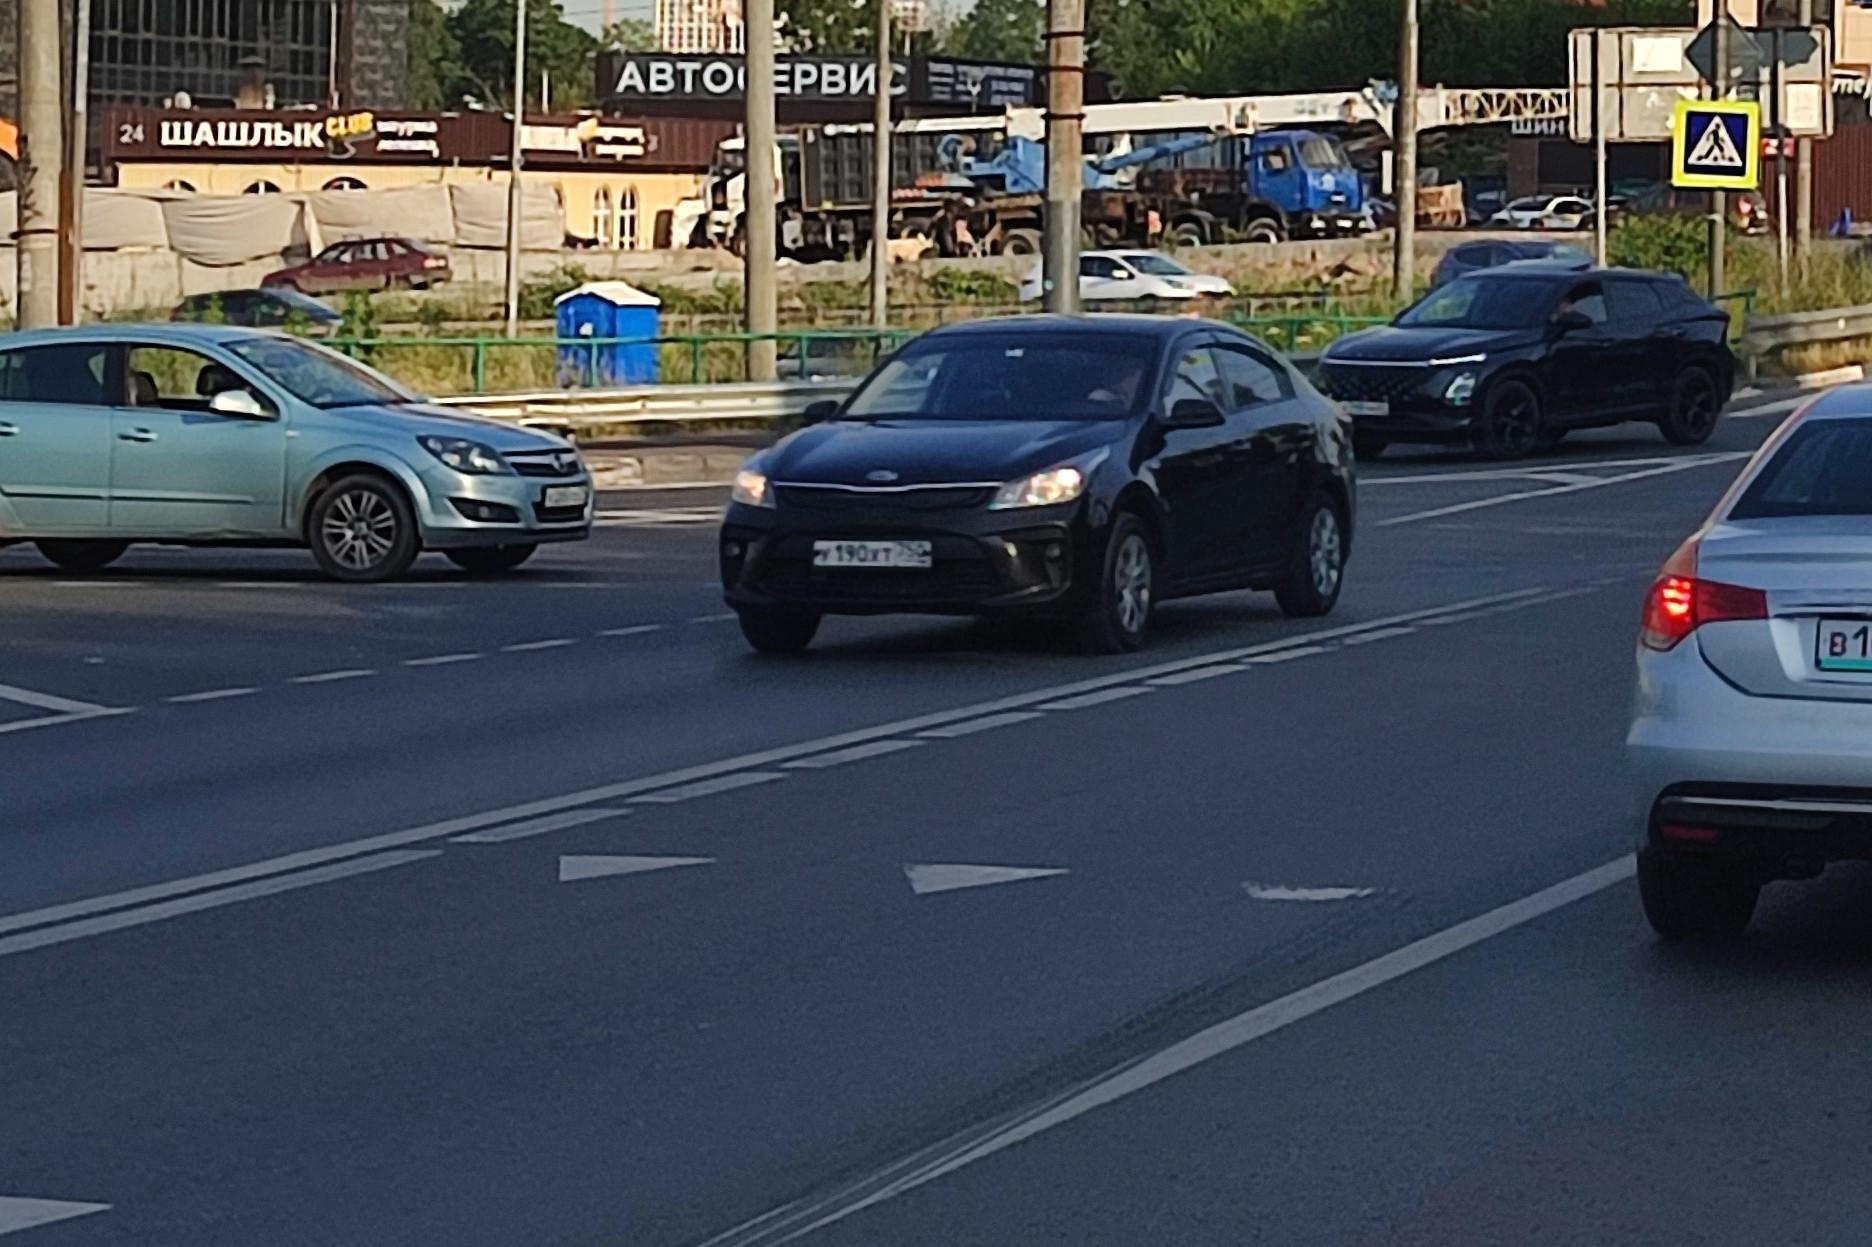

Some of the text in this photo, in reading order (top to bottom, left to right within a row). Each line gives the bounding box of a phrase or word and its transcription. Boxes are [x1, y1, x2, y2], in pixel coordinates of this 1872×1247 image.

[615, 60, 907, 95] АВТОЕРВИС
[119, 120, 325, 148] 24 ШАШЛЫК
